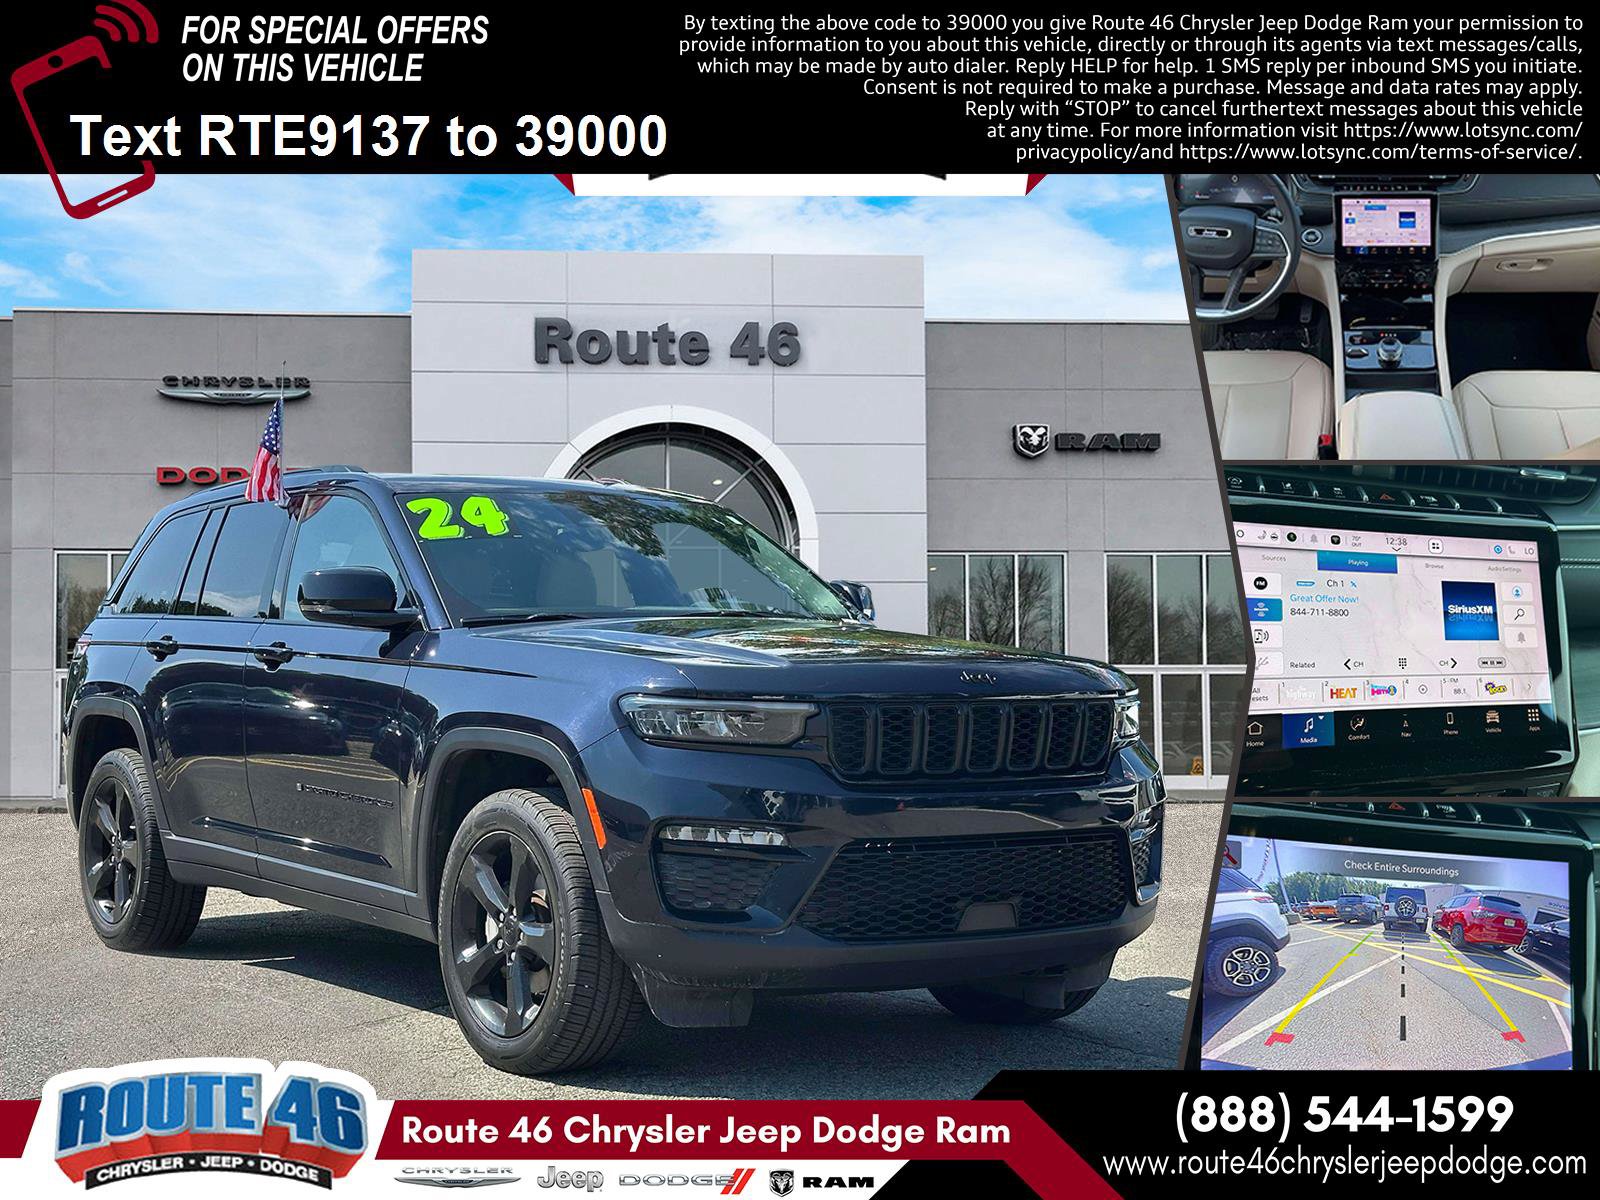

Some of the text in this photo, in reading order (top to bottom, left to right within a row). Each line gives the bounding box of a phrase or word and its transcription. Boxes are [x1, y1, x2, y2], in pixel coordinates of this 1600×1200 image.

[534, 317, 801, 367] Route 46
[162, 375, 311, 388] CHRYSLER
[1054, 432, 1161, 452] RAM
[156, 466, 251, 486] DOD
[405, 496, 510, 539] 24
[1385, 537, 1408, 546] 12:38
[1262, 554, 1287, 562] Sources
[1348, 558, 1369, 567] Playing
[1326, 579, 1338, 587] Ch
[1290, 594, 1359, 604] Great Offer Now!
[1290, 607, 1349, 617] 844-711-8800
[1448, 604, 1493, 614] SiriusXM
[1289, 661, 1316, 669] Related
[1353, 660, 1364, 668] CH
[1330, 687, 1357, 699] HEAT
[1348, 733, 1371, 741] Comfort
[1443, 728, 1459, 736] Phone
[1246, 740, 1264, 748] Home
[1343, 858, 1460, 878] Check Entire Surroundings
